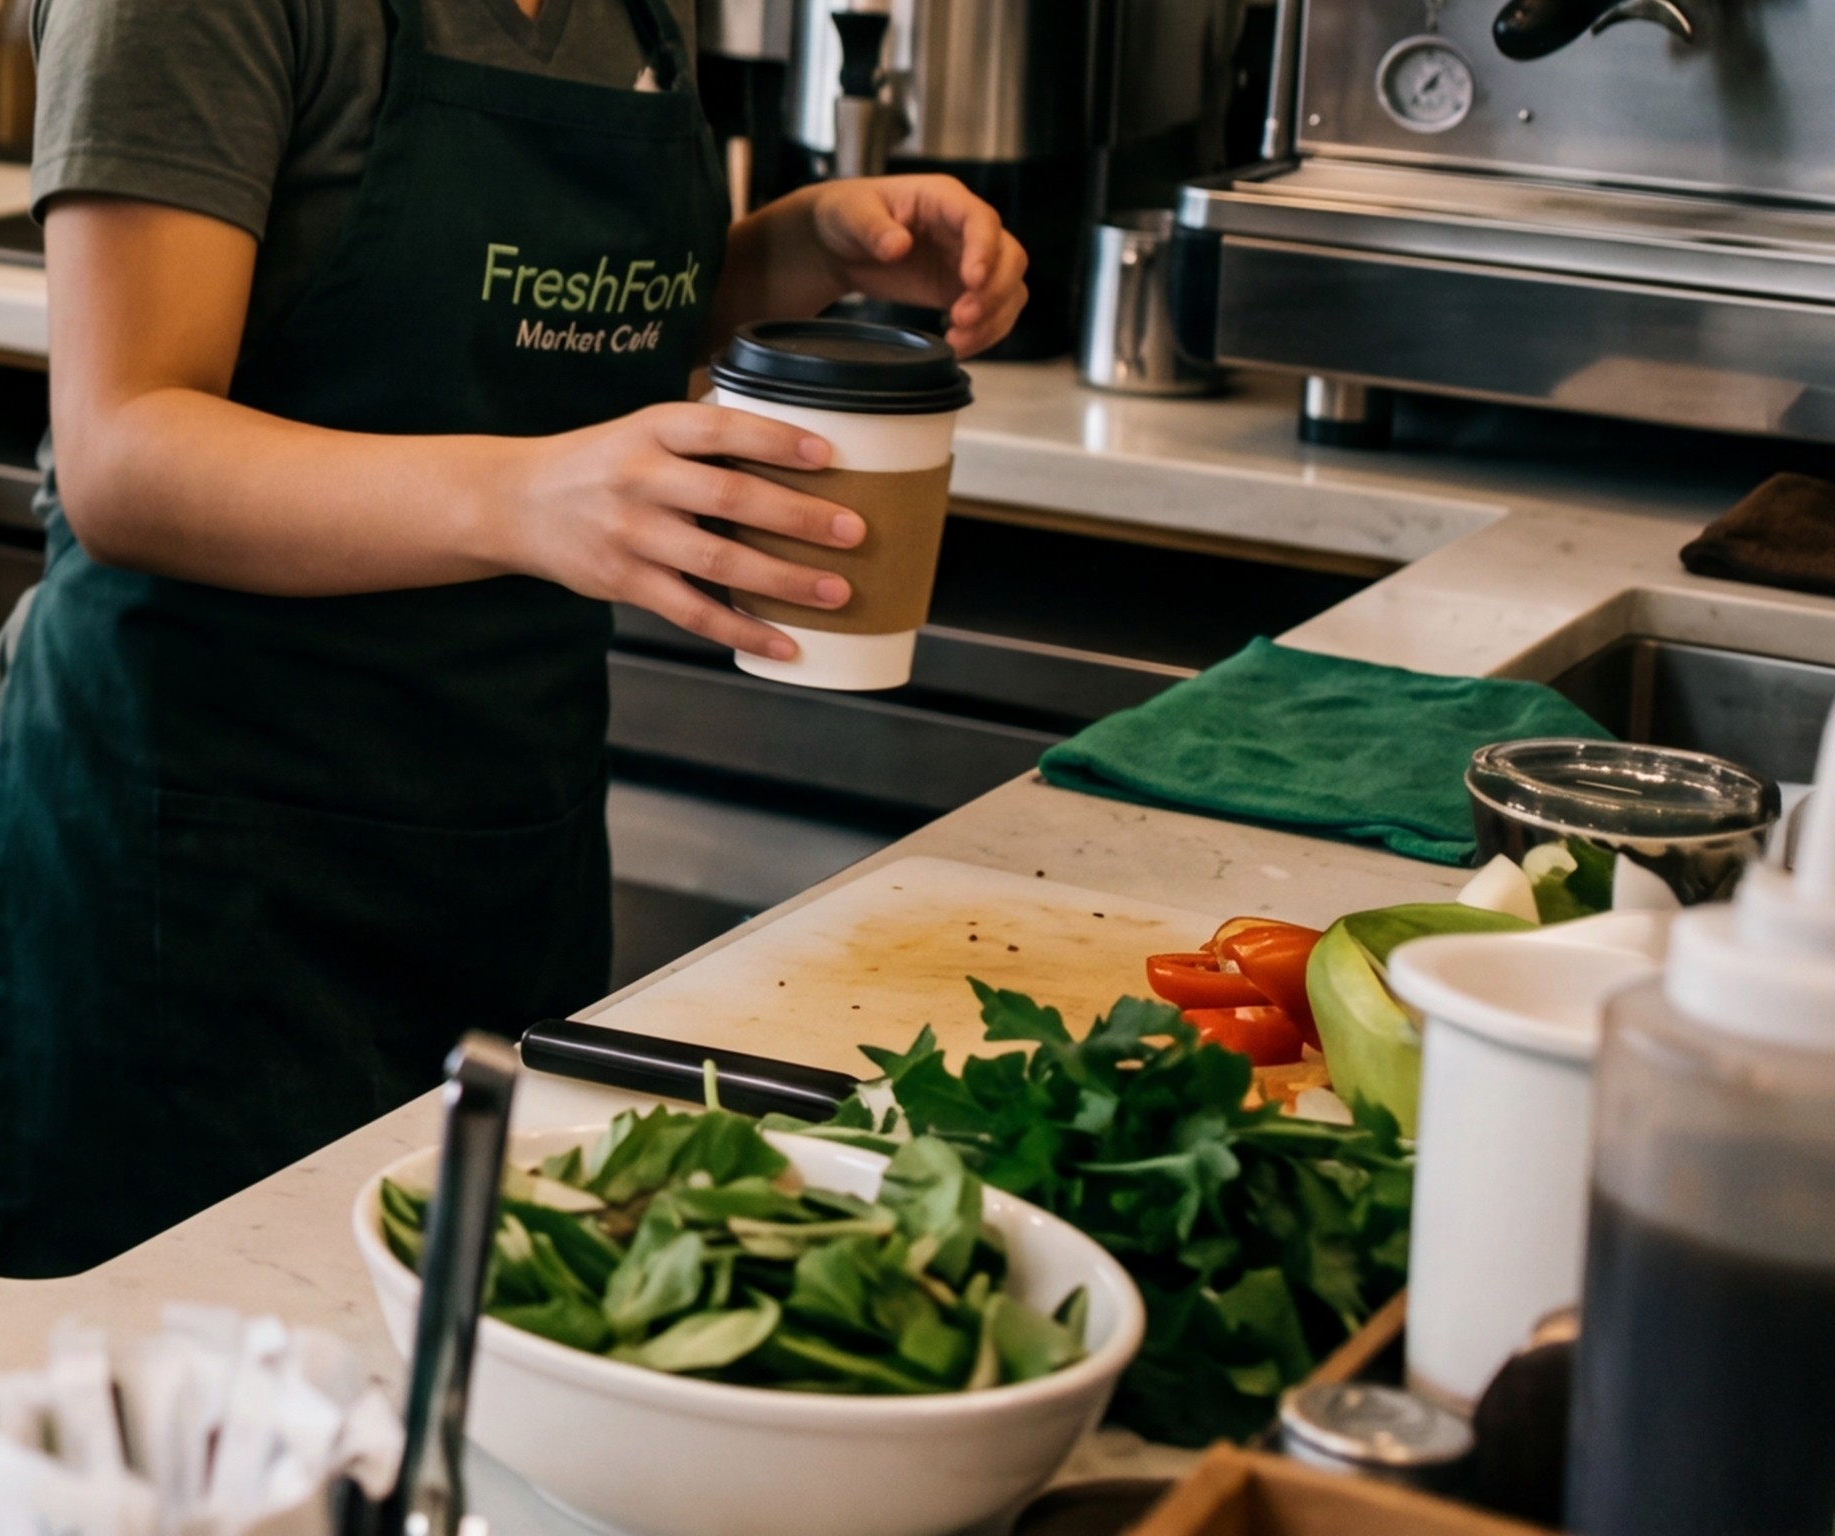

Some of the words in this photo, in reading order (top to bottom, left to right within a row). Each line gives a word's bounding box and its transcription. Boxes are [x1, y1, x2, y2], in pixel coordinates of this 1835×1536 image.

[481, 242, 700, 313] FreshFork
[516, 319, 605, 353] Market
[610, 321, 663, 353] Café
